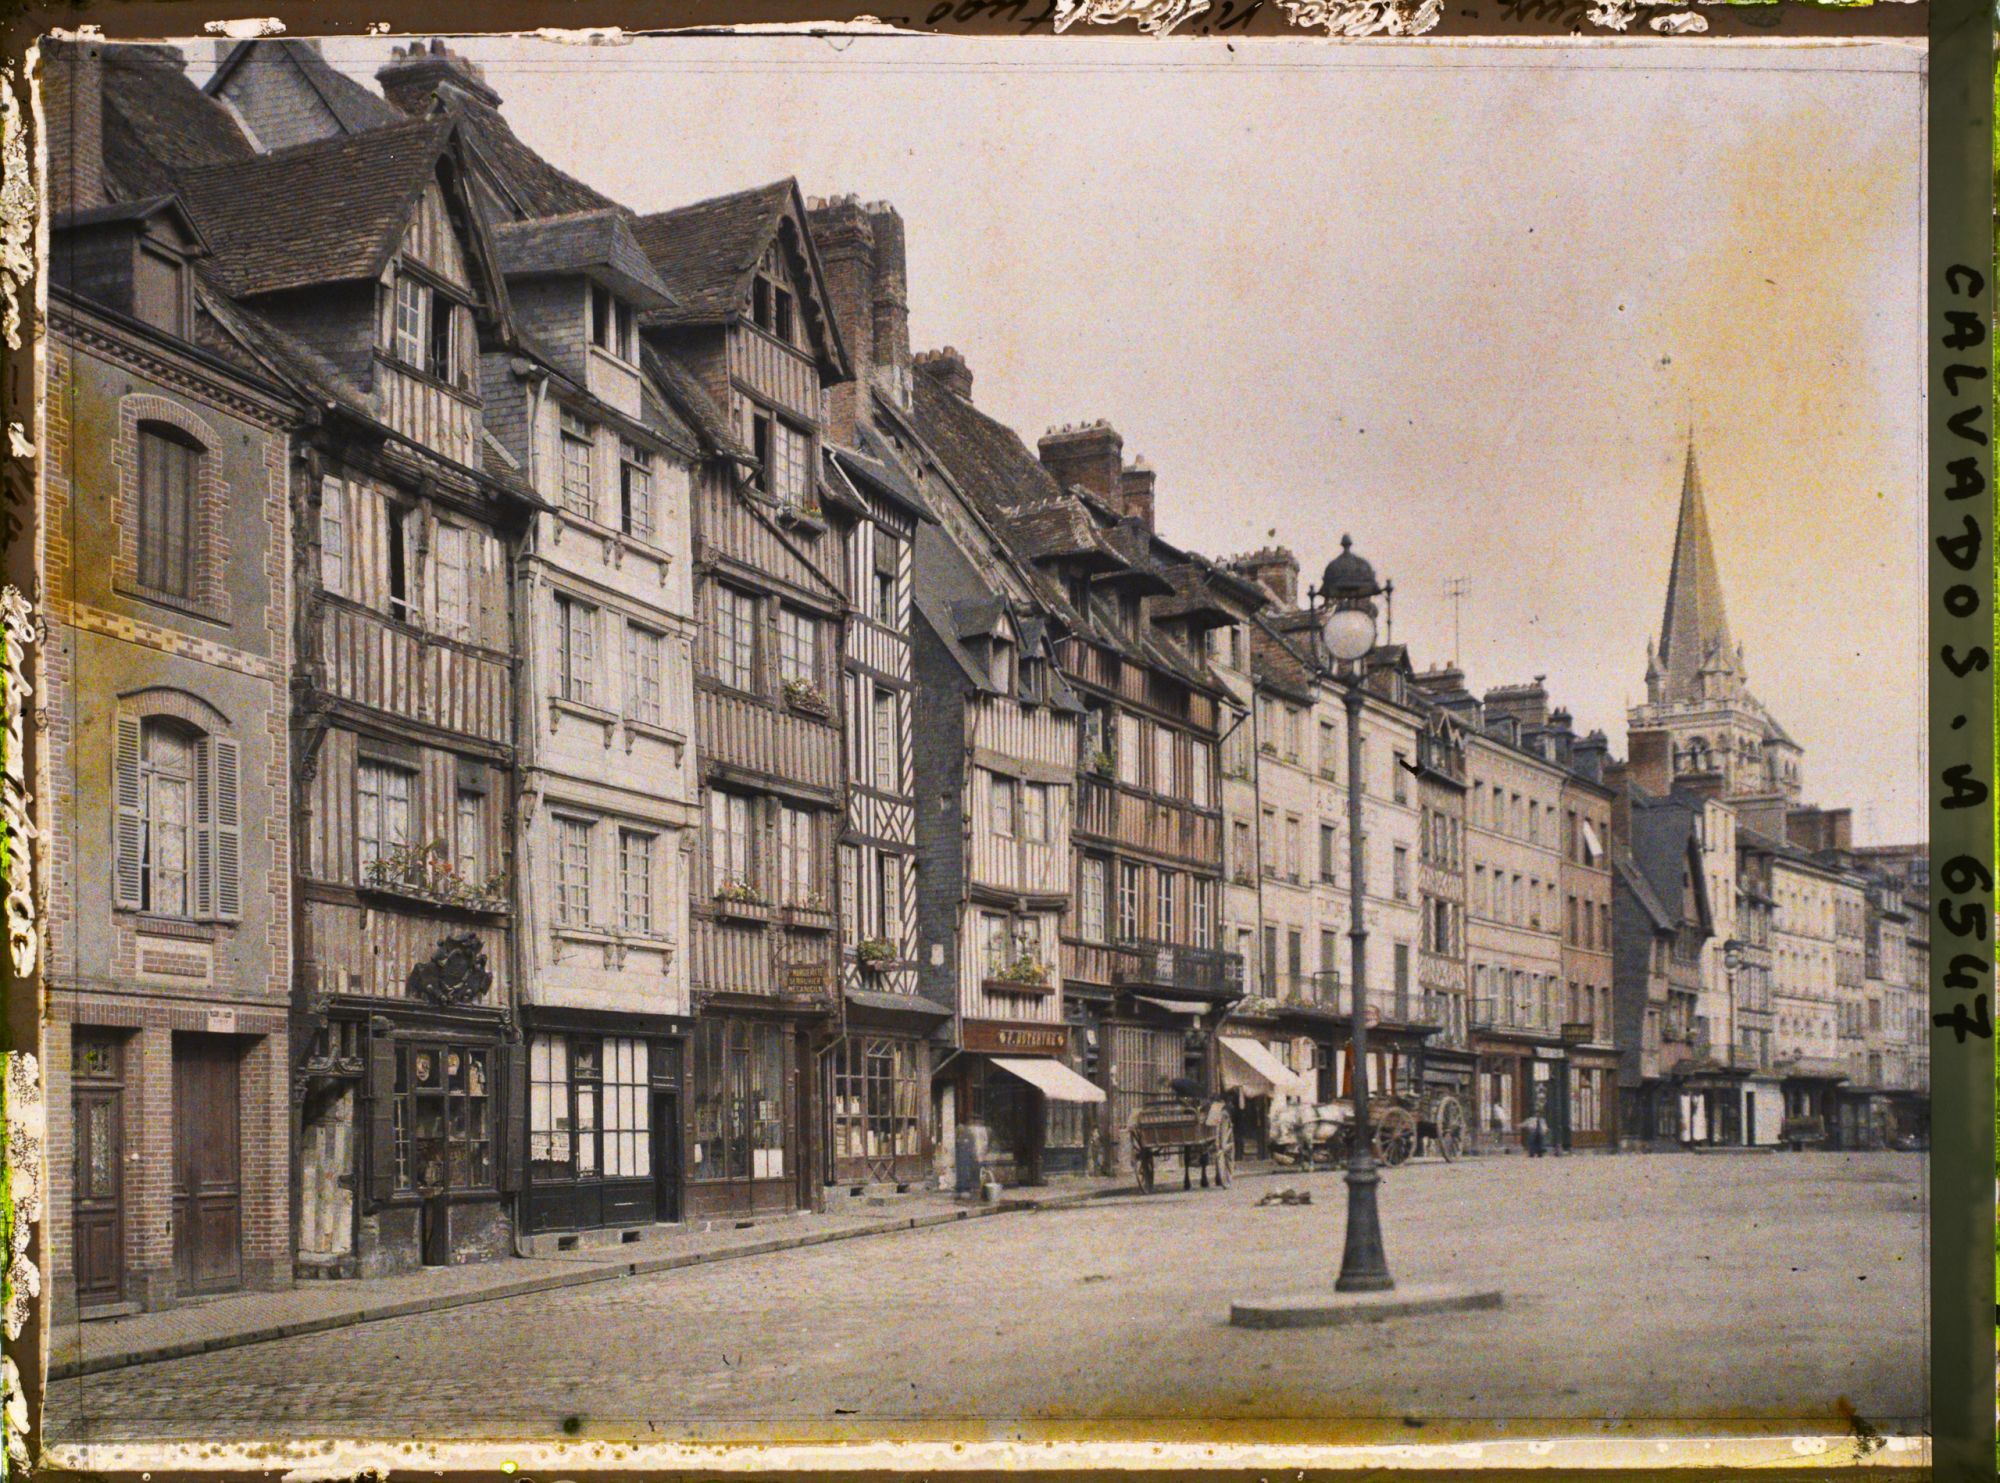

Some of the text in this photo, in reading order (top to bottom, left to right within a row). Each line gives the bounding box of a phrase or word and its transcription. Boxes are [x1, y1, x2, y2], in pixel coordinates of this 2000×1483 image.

[1932, 263, 1994, 1044] CALVADOS A 6547
